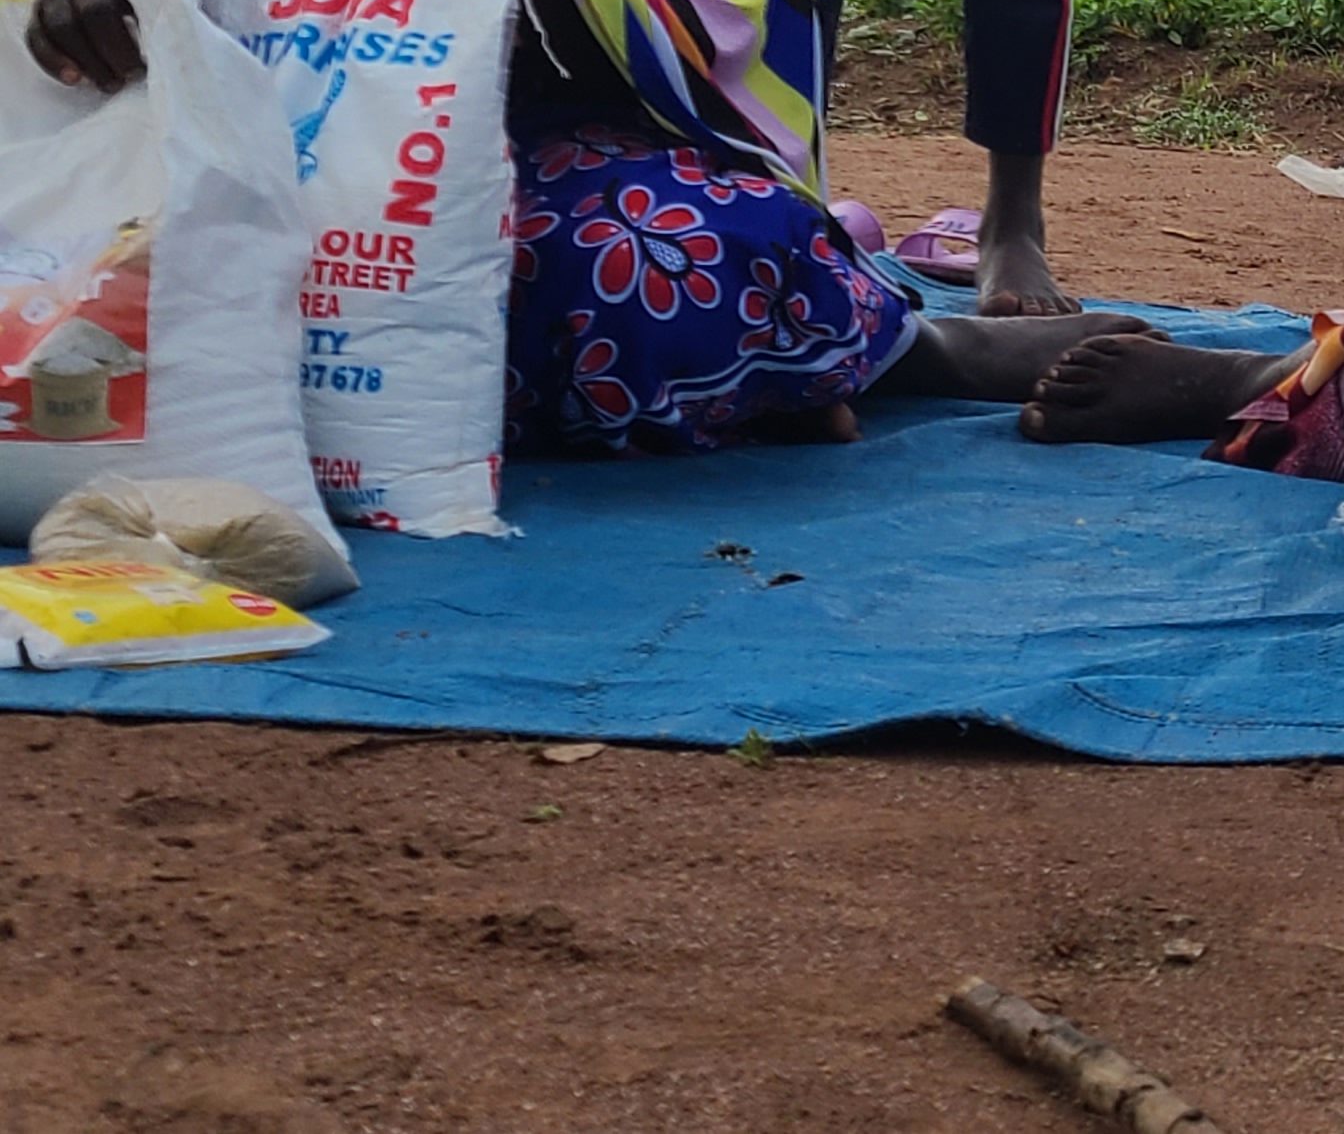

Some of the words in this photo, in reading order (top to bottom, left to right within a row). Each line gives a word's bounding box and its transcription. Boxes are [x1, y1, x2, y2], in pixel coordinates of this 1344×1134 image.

[313, 229, 416, 265] OUR
[303, 260, 414, 293] TREET
[299, 293, 341, 319] REA
